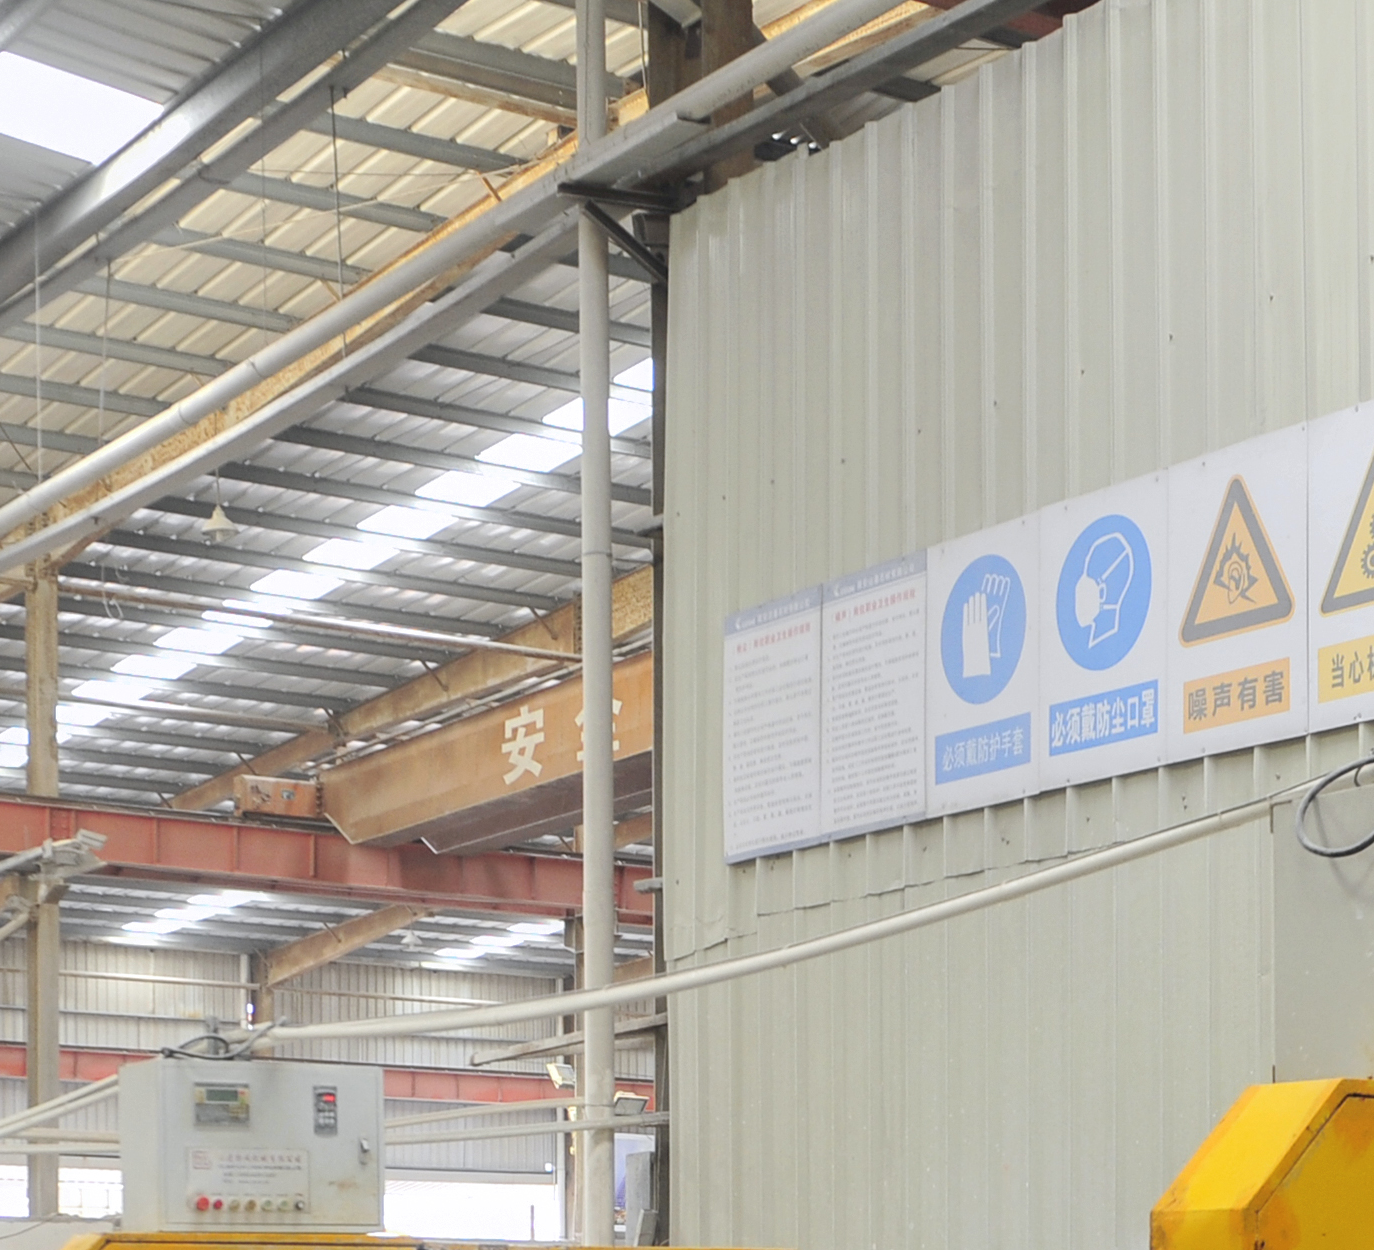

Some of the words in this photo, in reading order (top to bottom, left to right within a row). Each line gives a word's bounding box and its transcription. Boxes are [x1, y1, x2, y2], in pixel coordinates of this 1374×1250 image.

[1051, 688, 1156, 748] 必须戴防尘口罩
[1187, 669, 1285, 722] 噪声有害
[942, 726, 1025, 772] 必须戴防护手套
